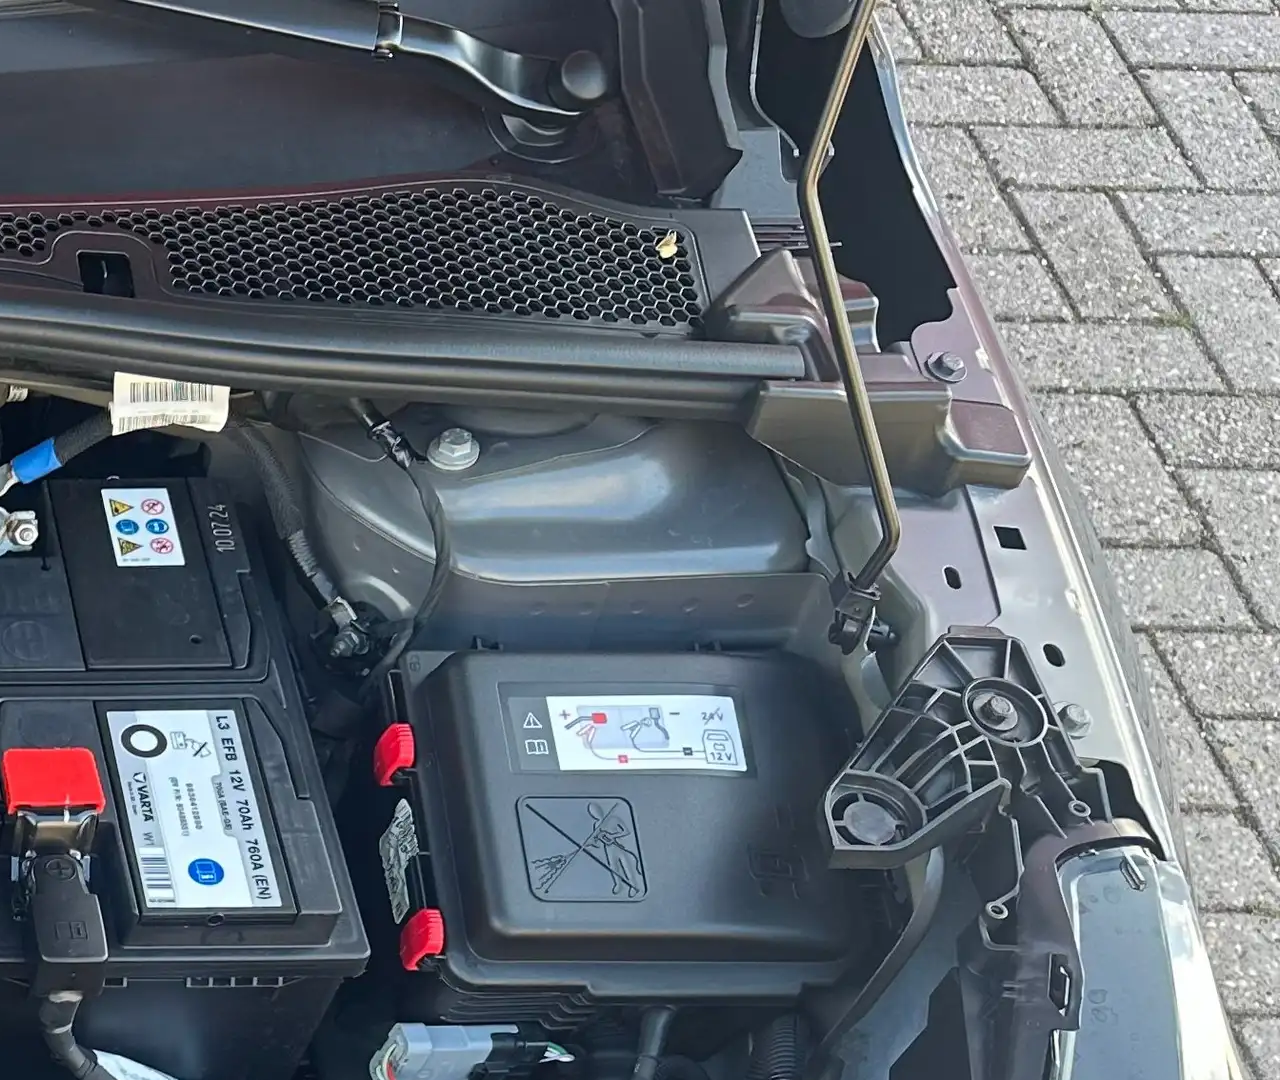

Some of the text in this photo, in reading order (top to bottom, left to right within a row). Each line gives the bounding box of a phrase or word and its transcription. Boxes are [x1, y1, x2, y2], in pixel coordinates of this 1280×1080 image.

[137, 786, 154, 823] VARTA
[215, 715, 272, 900] L3 EFB 12V 70Ah 760A (EN)
